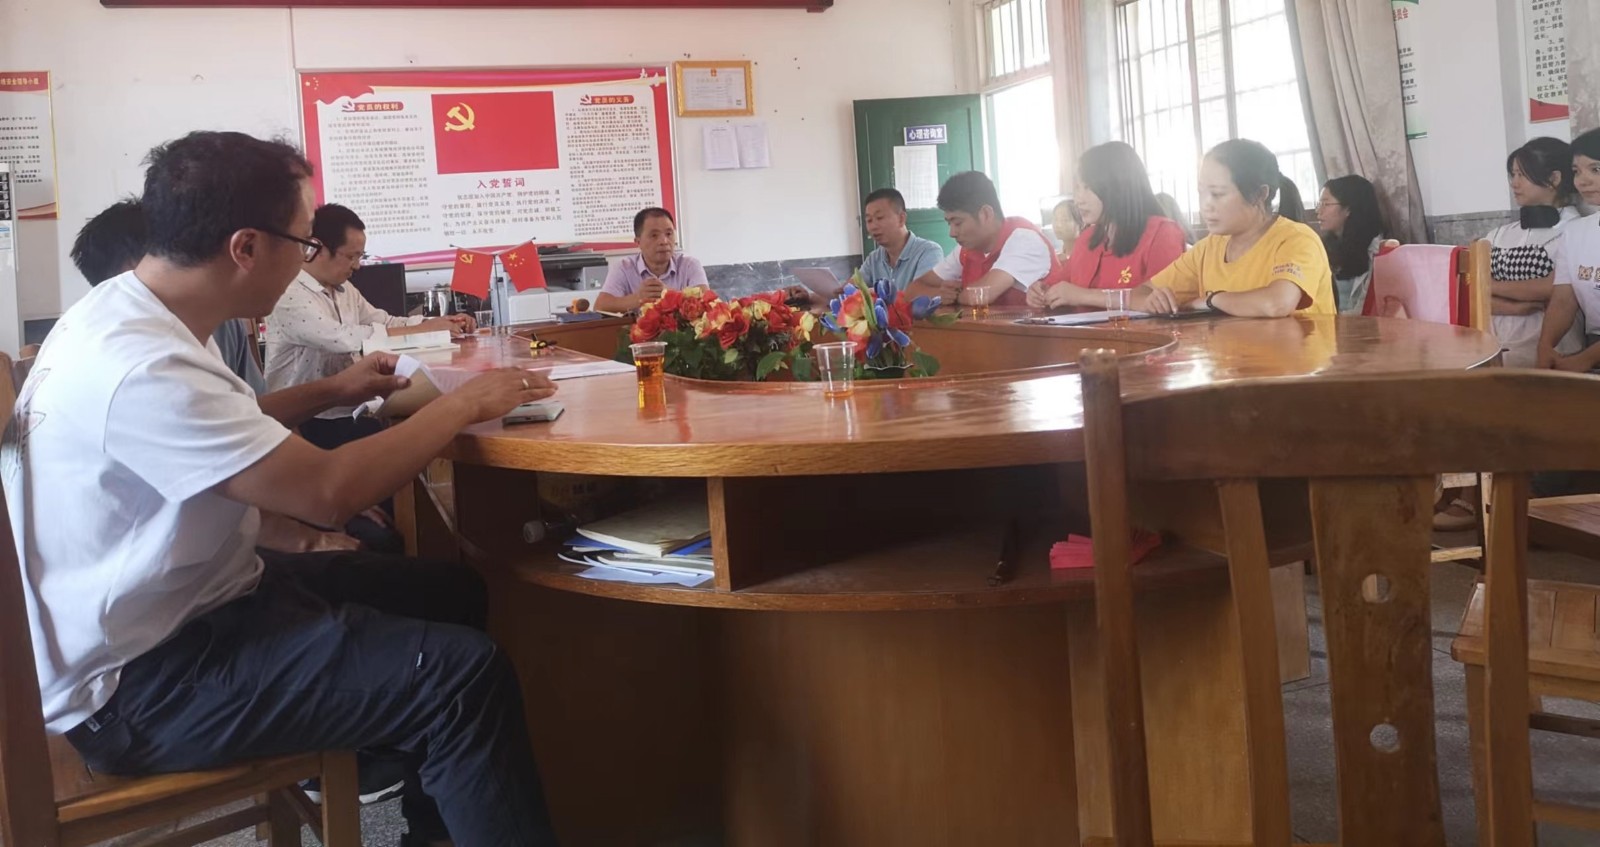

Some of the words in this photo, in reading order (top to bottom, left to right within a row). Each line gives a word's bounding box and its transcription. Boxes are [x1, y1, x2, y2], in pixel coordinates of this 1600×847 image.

[357, 103, 399, 111] 党员的权利
[908, 127, 944, 140] 心理咨询室
[477, 177, 526, 189] 入党誓词
